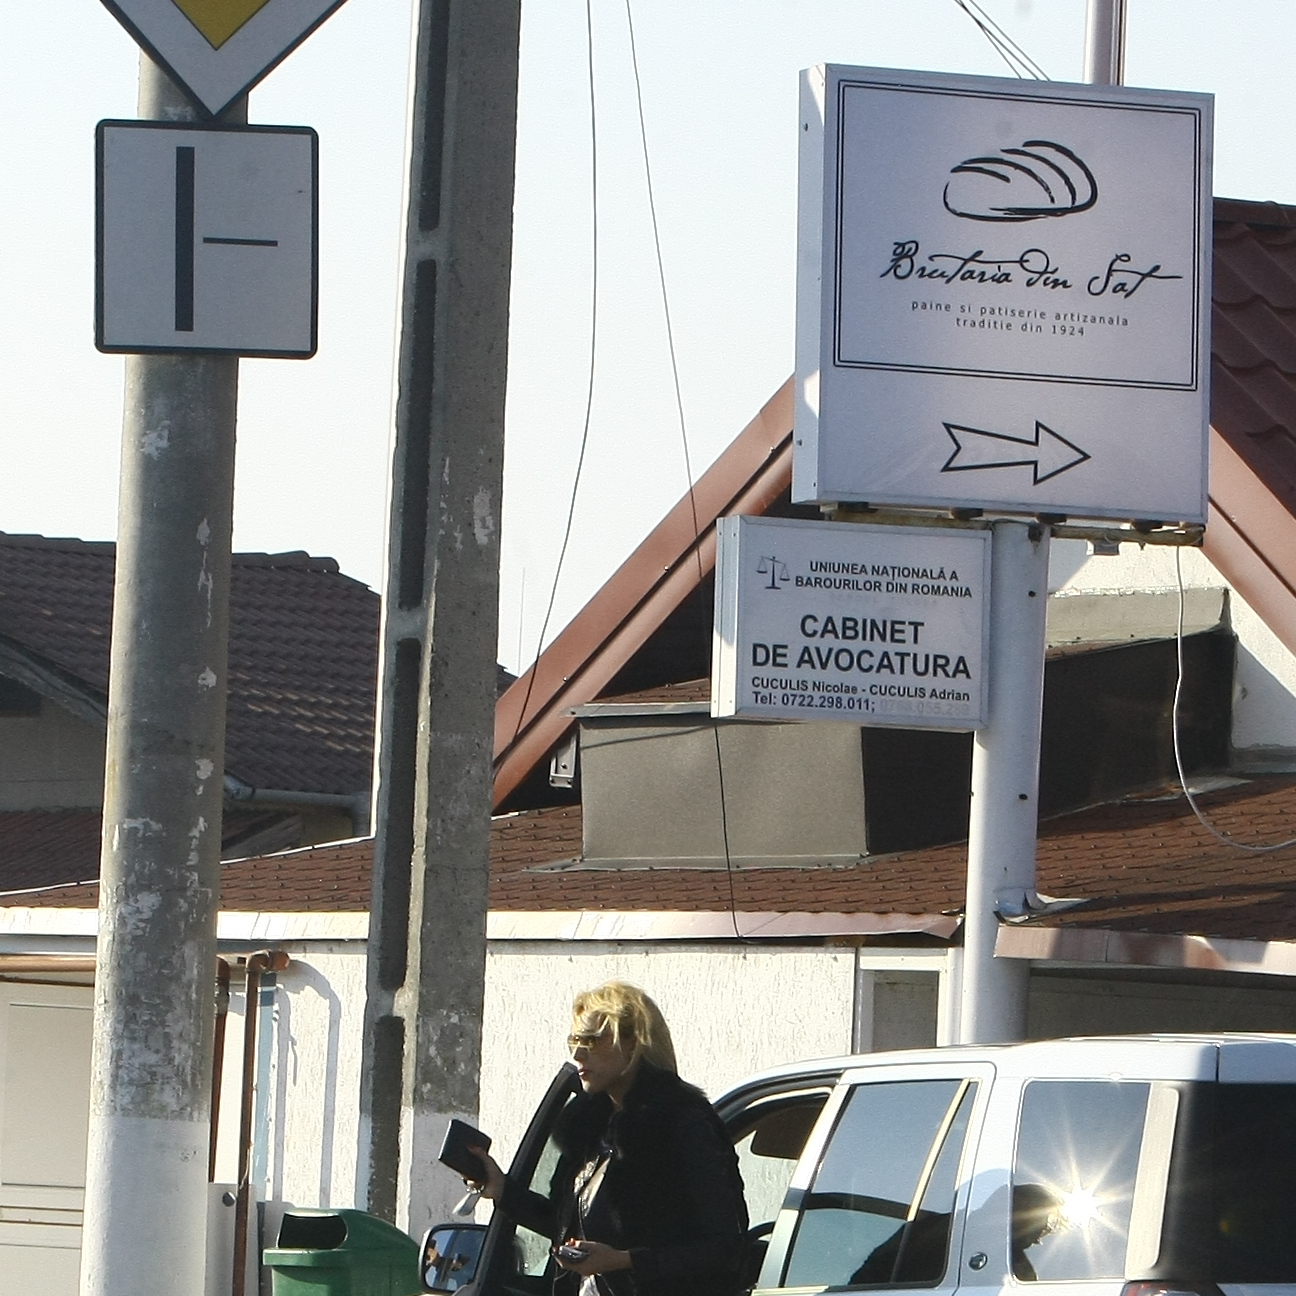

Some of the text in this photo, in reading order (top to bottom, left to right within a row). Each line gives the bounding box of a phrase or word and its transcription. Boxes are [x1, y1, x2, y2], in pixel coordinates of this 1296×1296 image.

[880, 240, 1183, 299] Brutaria din Sat
[911, 300, 1129, 327] paine si patiserie artizanala
[956, 317, 1086, 337] traditie din 1924
[809, 560, 868, 576] UNIUNEA
[949, 570, 959, 581] A
[795, 576, 973, 598] BAROURILOR DIN ROMANIA
[800, 614, 925, 645] CABINET
[751, 643, 973, 680] DE AVOCATURA
[751, 676, 809, 692] CUCULIS
[812, 680, 858, 695] Nicolae
[869, 684, 927, 699] CUCULIS
[929, 688, 971, 701] Adrian
[751, 690, 778, 706] Tel:
